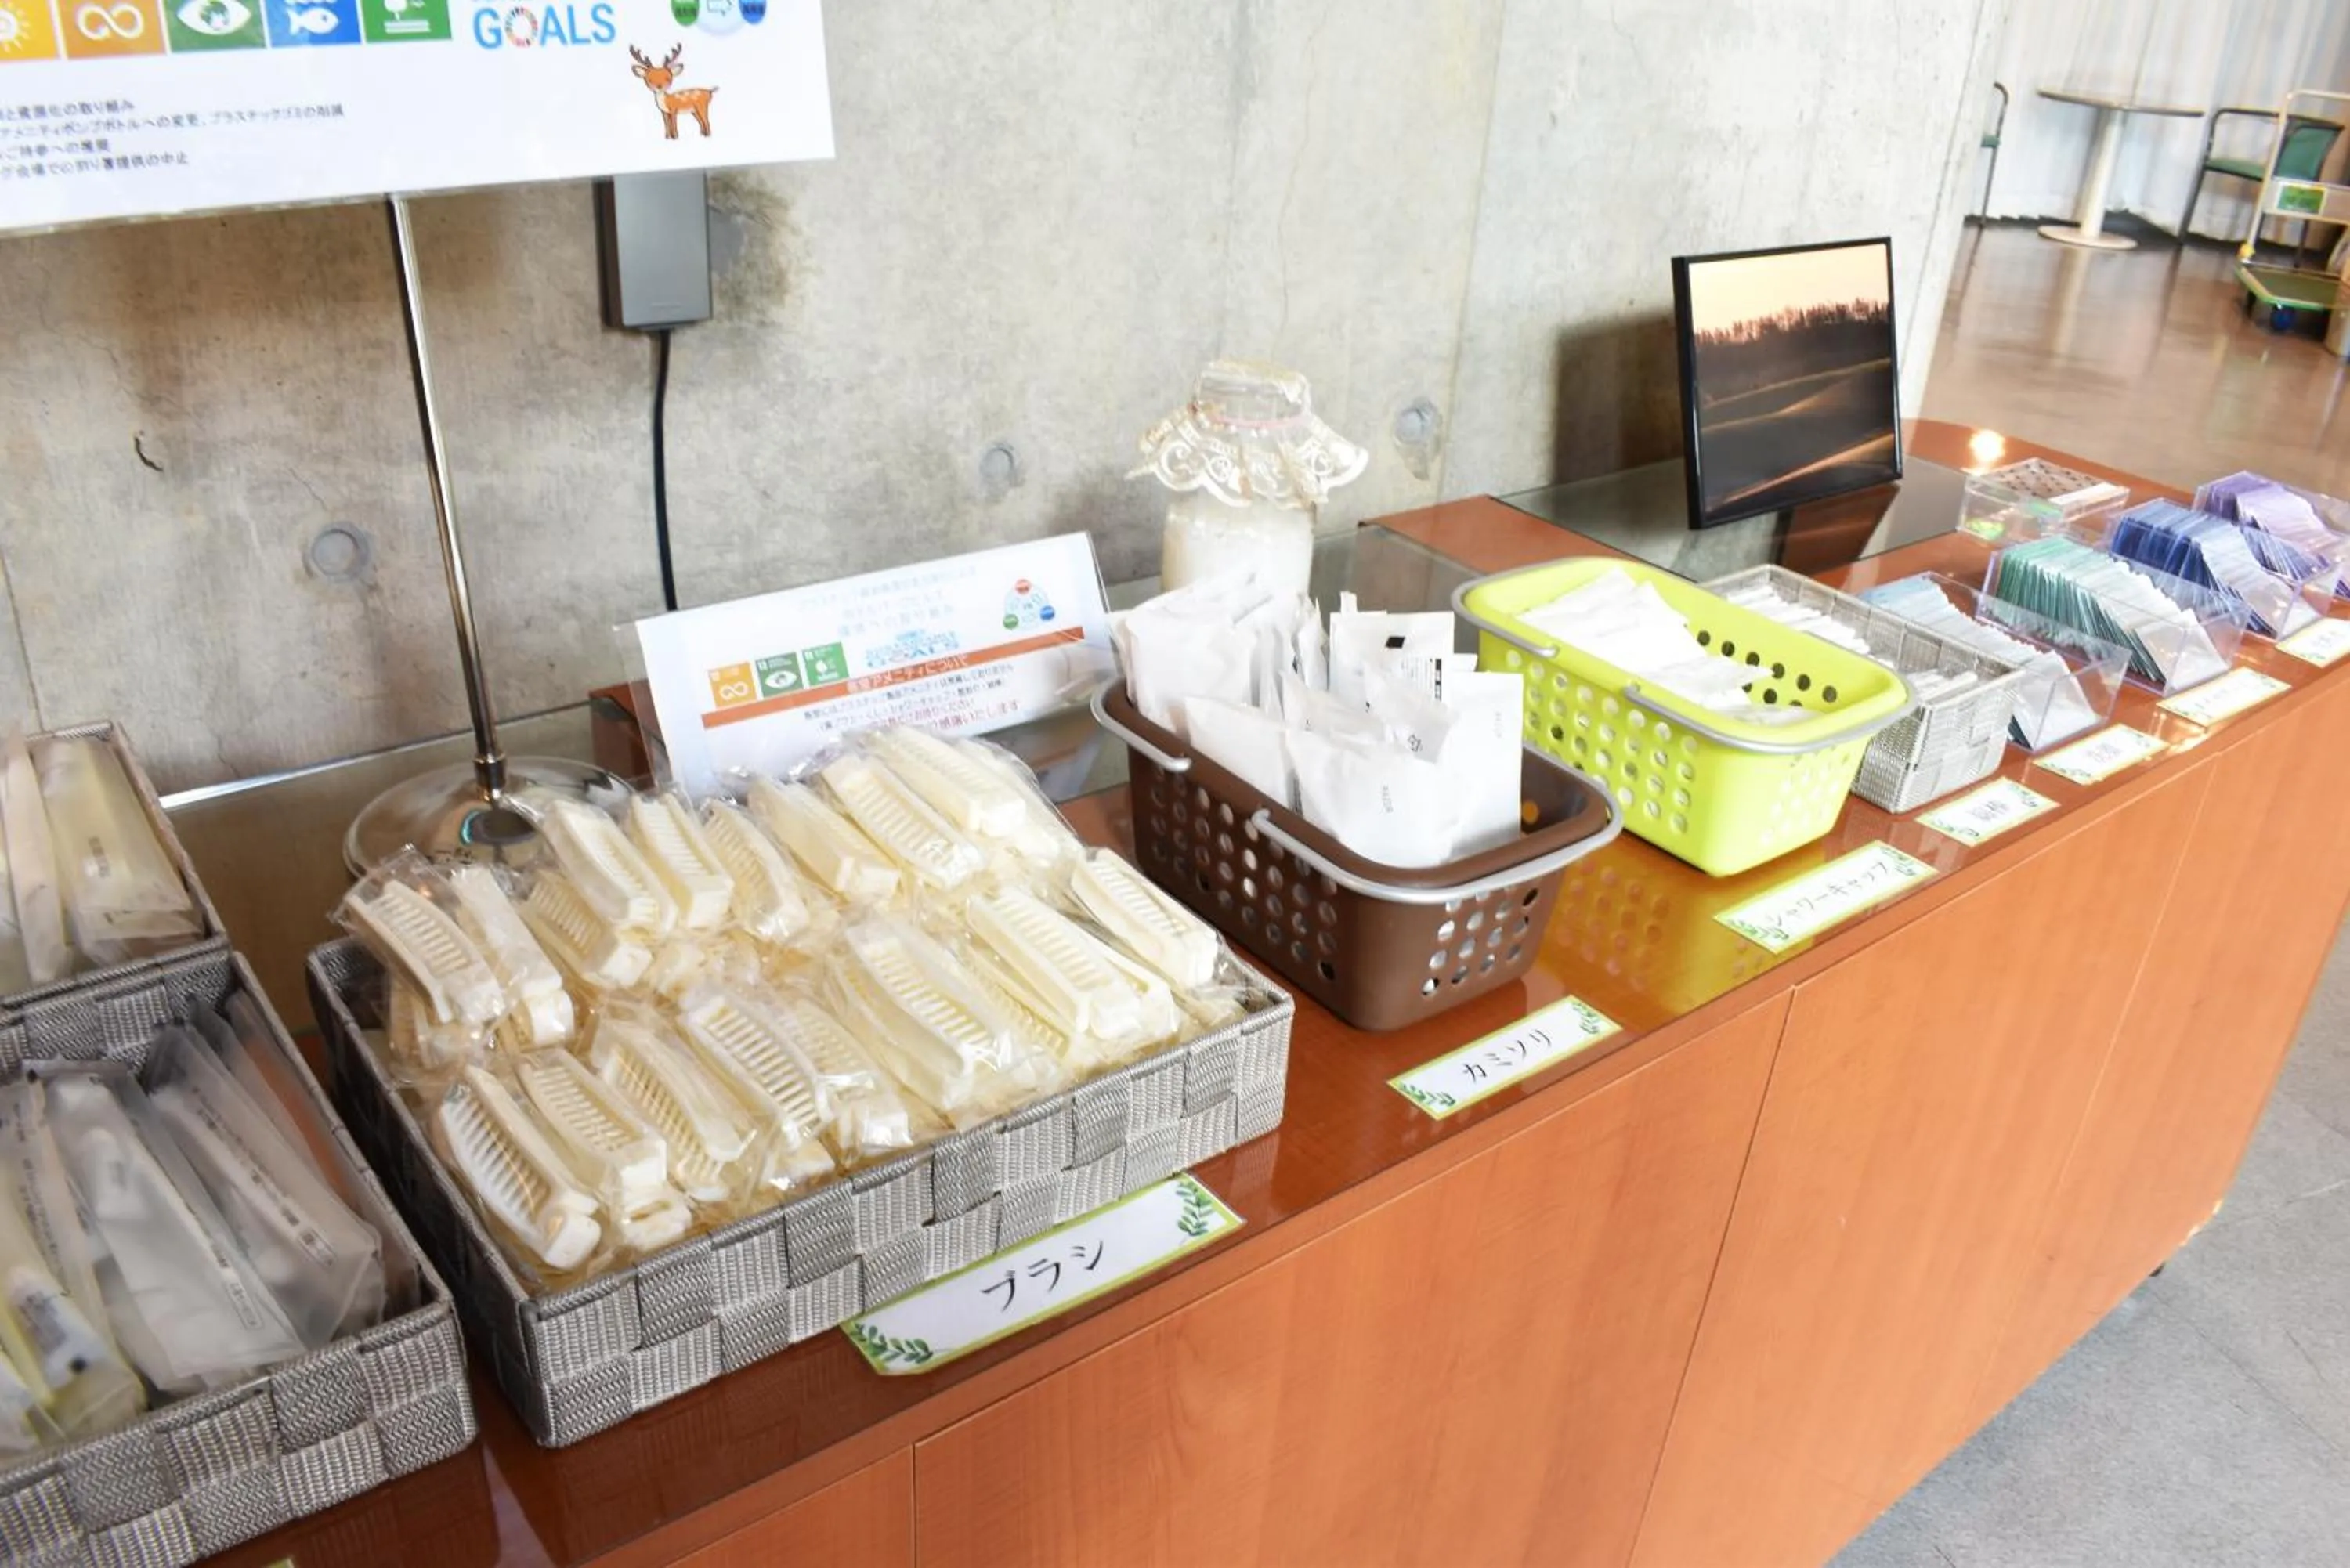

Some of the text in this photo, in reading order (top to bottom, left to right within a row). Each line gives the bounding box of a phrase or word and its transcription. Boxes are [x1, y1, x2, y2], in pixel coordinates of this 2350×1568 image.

[472, 3, 616, 50] GOALS
[1462, 1028, 1552, 1083] カミソリ
[981, 1240, 1104, 1312] ブラシ
